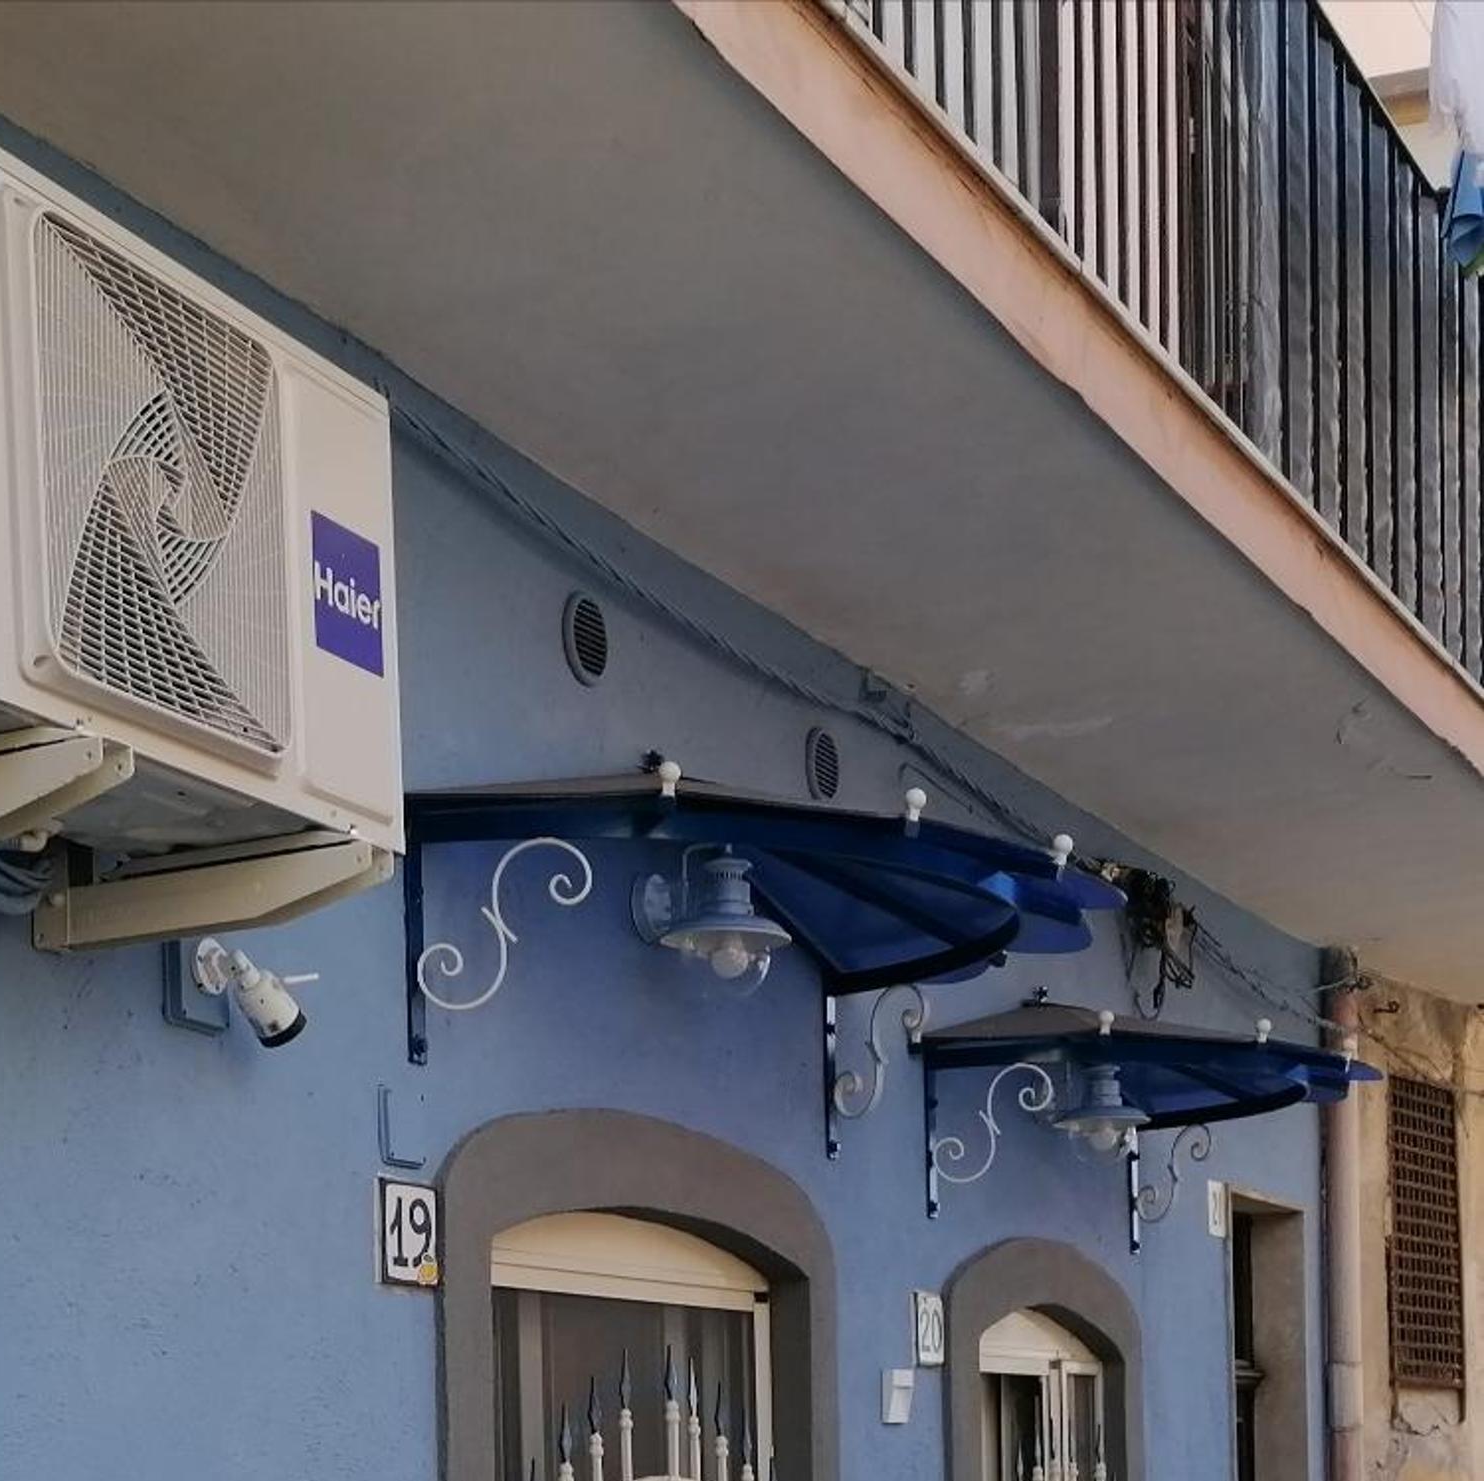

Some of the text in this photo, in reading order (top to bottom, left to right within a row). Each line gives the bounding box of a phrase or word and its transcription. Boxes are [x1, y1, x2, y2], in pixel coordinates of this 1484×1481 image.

[314, 560, 382, 631] Haier
[390, 1196, 432, 1267] 19
[920, 1309, 942, 1353] 20
